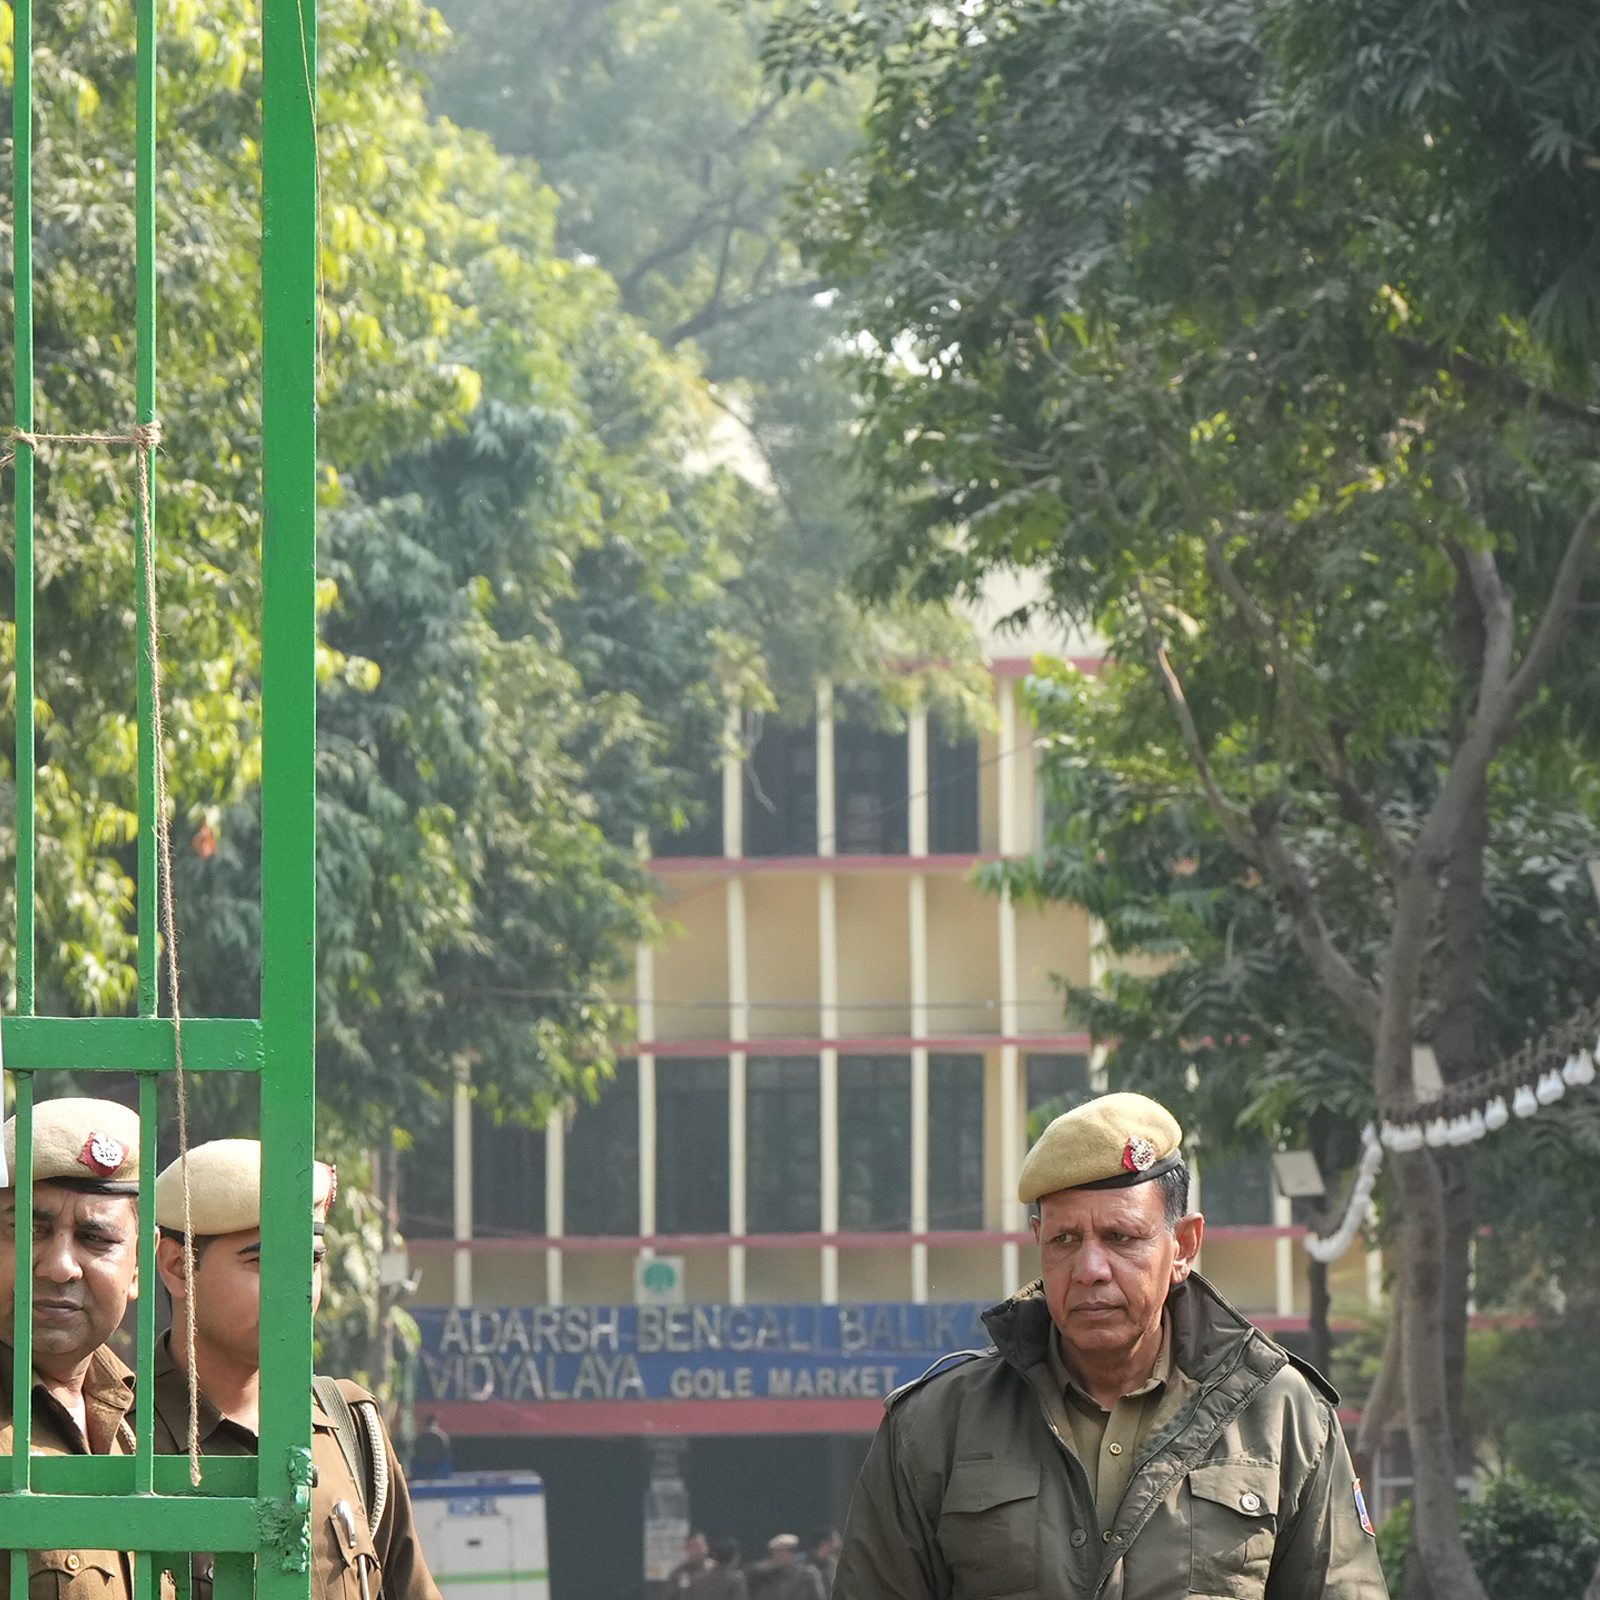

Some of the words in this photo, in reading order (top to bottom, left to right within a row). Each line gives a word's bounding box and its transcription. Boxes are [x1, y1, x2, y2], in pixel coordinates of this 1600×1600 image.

[440, 1306, 620, 1352] ADARSH
[638, 1303, 822, 1351] BENGALI
[424, 1353, 646, 1400] VIDYALAYA
[670, 1367, 753, 1399] GOLE
[768, 1365, 898, 1398] MARKET
